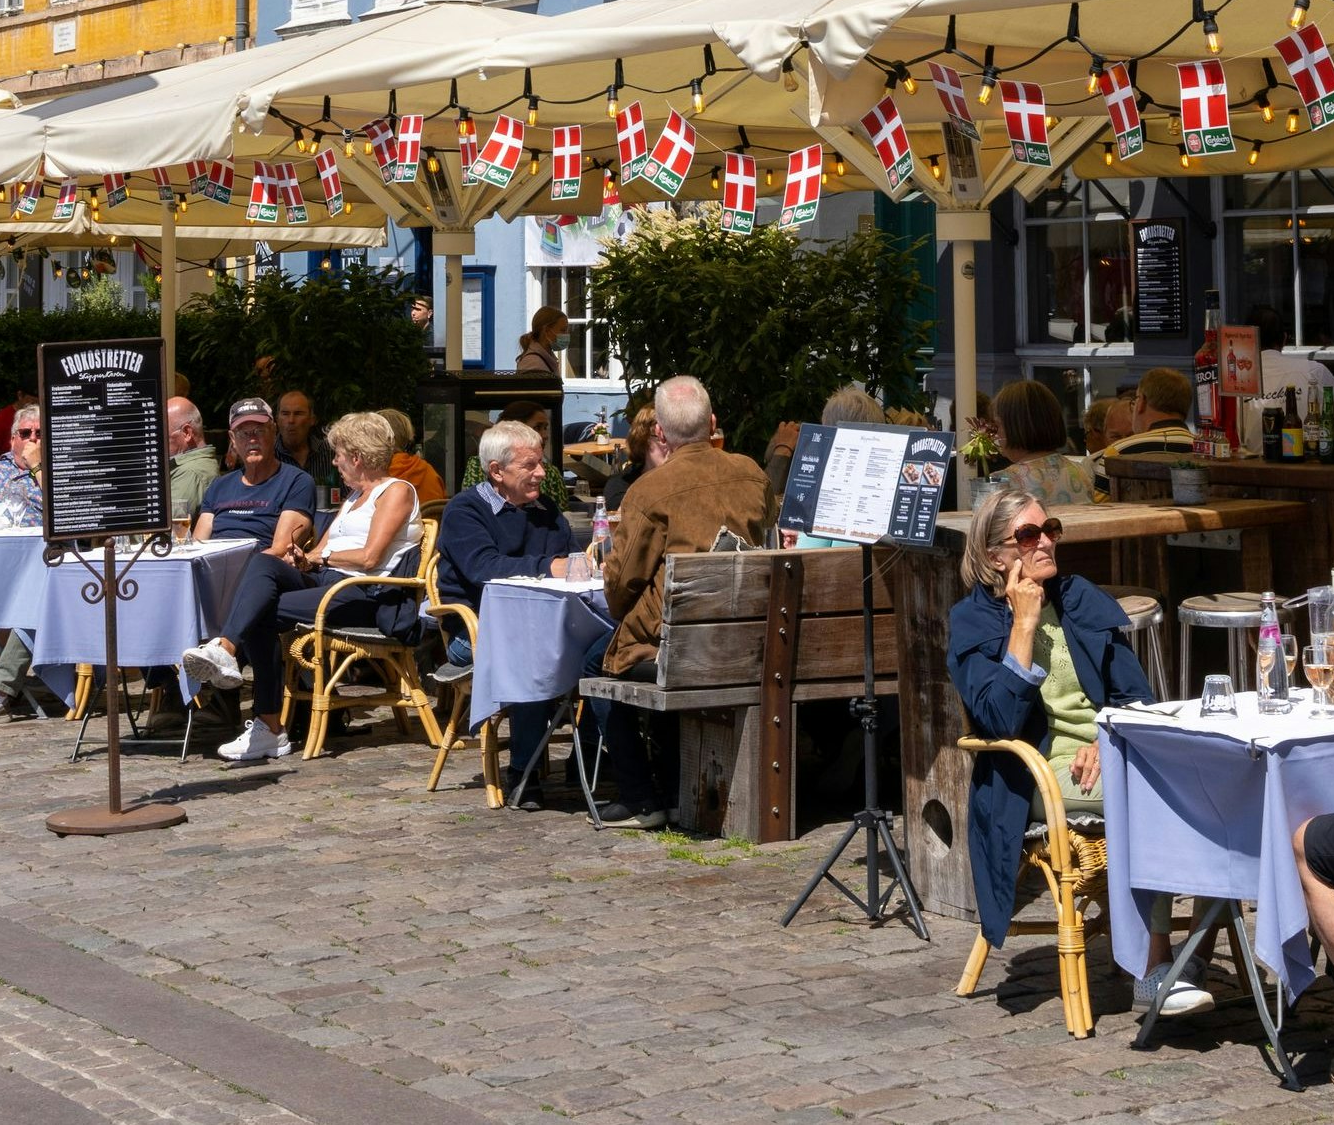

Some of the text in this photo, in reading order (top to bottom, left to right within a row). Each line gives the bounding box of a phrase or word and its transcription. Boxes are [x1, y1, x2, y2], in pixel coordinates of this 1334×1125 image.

[1205, 133, 1230, 147] Carlsberg
[1028, 147, 1049, 162] Carlsberg
[60, 348, 144, 377] FROKOSTRETTER
